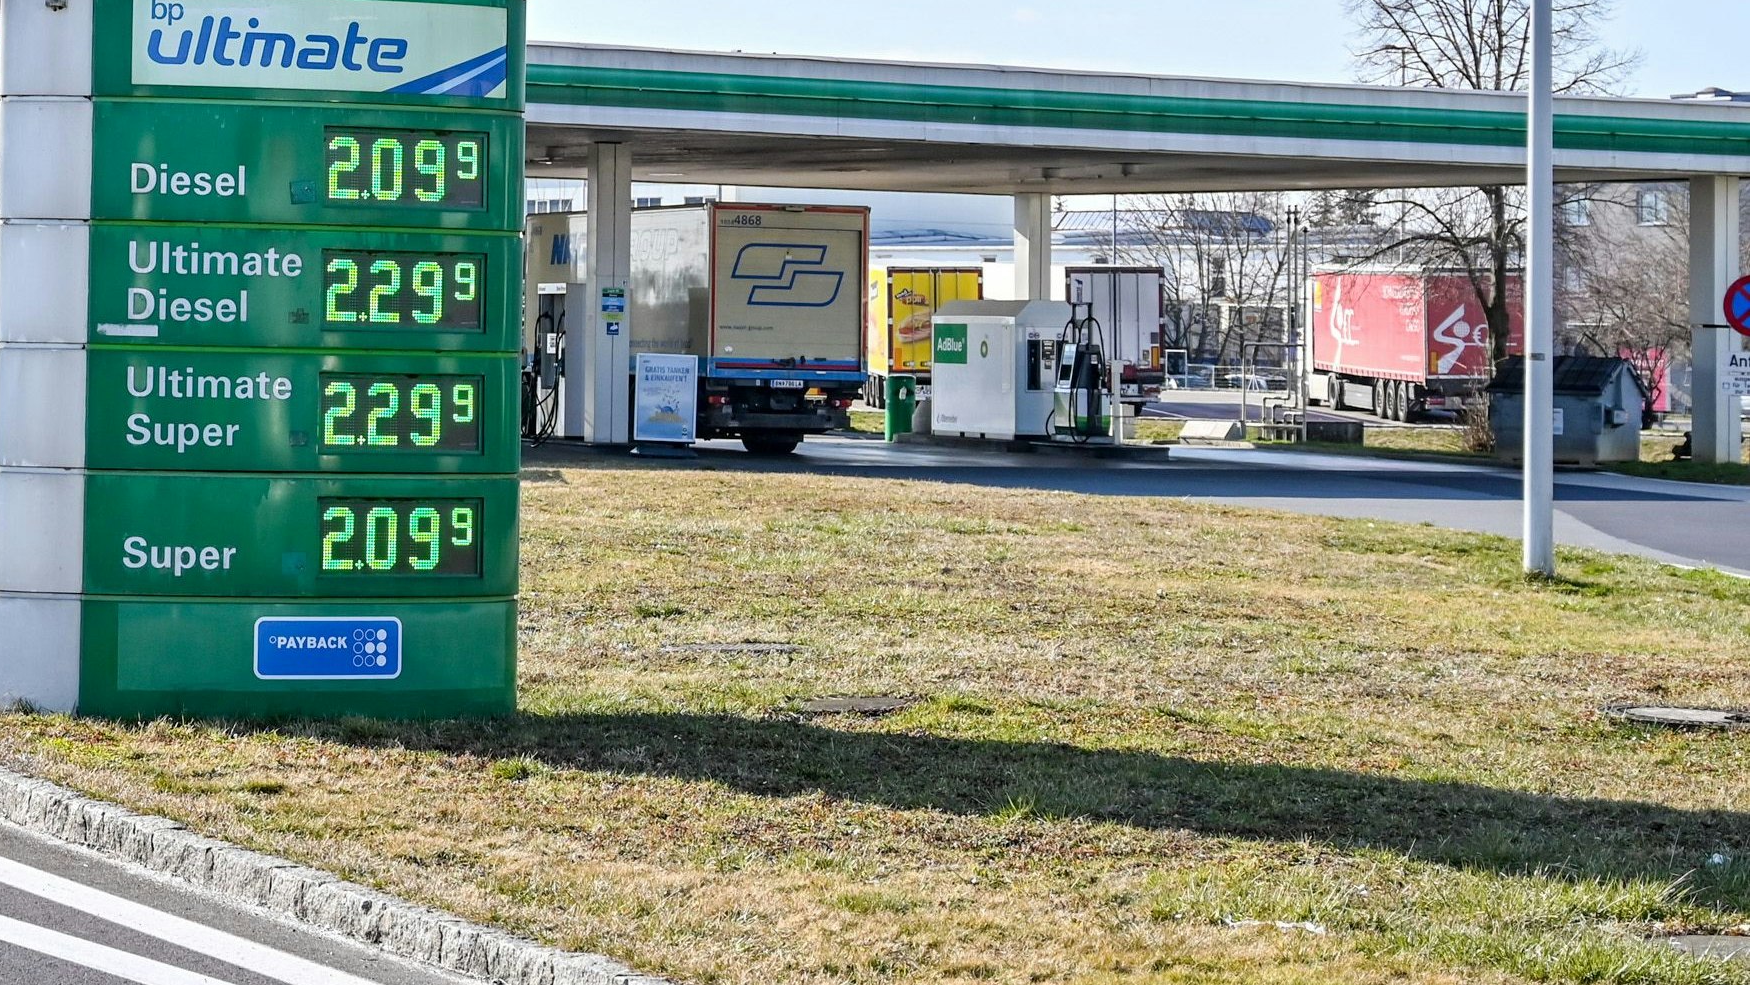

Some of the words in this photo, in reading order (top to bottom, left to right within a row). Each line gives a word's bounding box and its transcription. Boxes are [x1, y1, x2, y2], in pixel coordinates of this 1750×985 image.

[147, 14, 409, 74] ultimate
[130, 162, 247, 197] Diesel
[128, 240, 302, 278] Ultimate
[127, 287, 248, 323] Diesel
[126, 365, 293, 400] Ultimate
[126, 413, 240, 454] Super
[122, 536, 237, 577] Super
